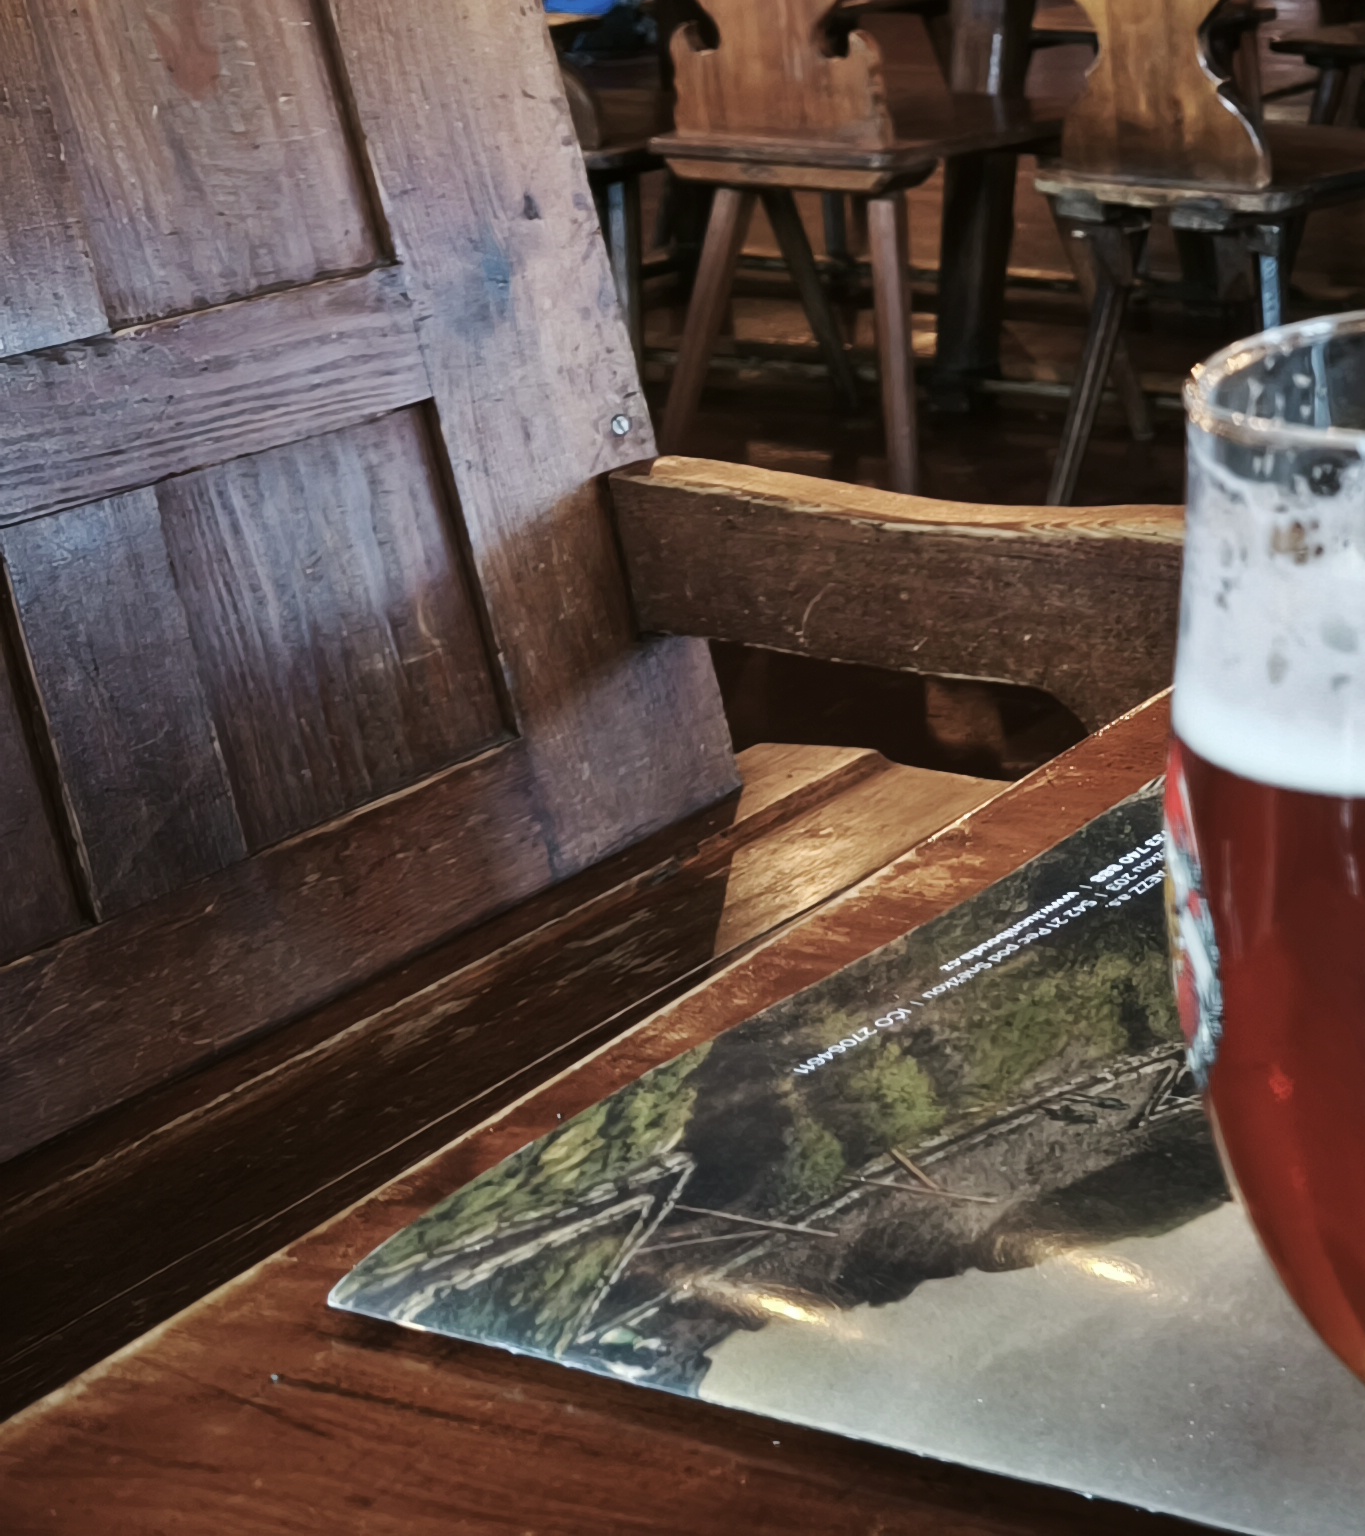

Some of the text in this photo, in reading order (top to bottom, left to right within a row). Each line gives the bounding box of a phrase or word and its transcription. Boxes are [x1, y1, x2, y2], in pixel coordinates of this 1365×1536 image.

[1118, 846, 1151, 864] 740
[1105, 872, 1138, 891] 203
[1062, 899, 1098, 918] 542
[1045, 916, 1069, 928] 21
[1017, 927, 1052, 944] Pec
[988, 943, 1020, 963] pod
[793, 1026, 878, 1075] 27064611
